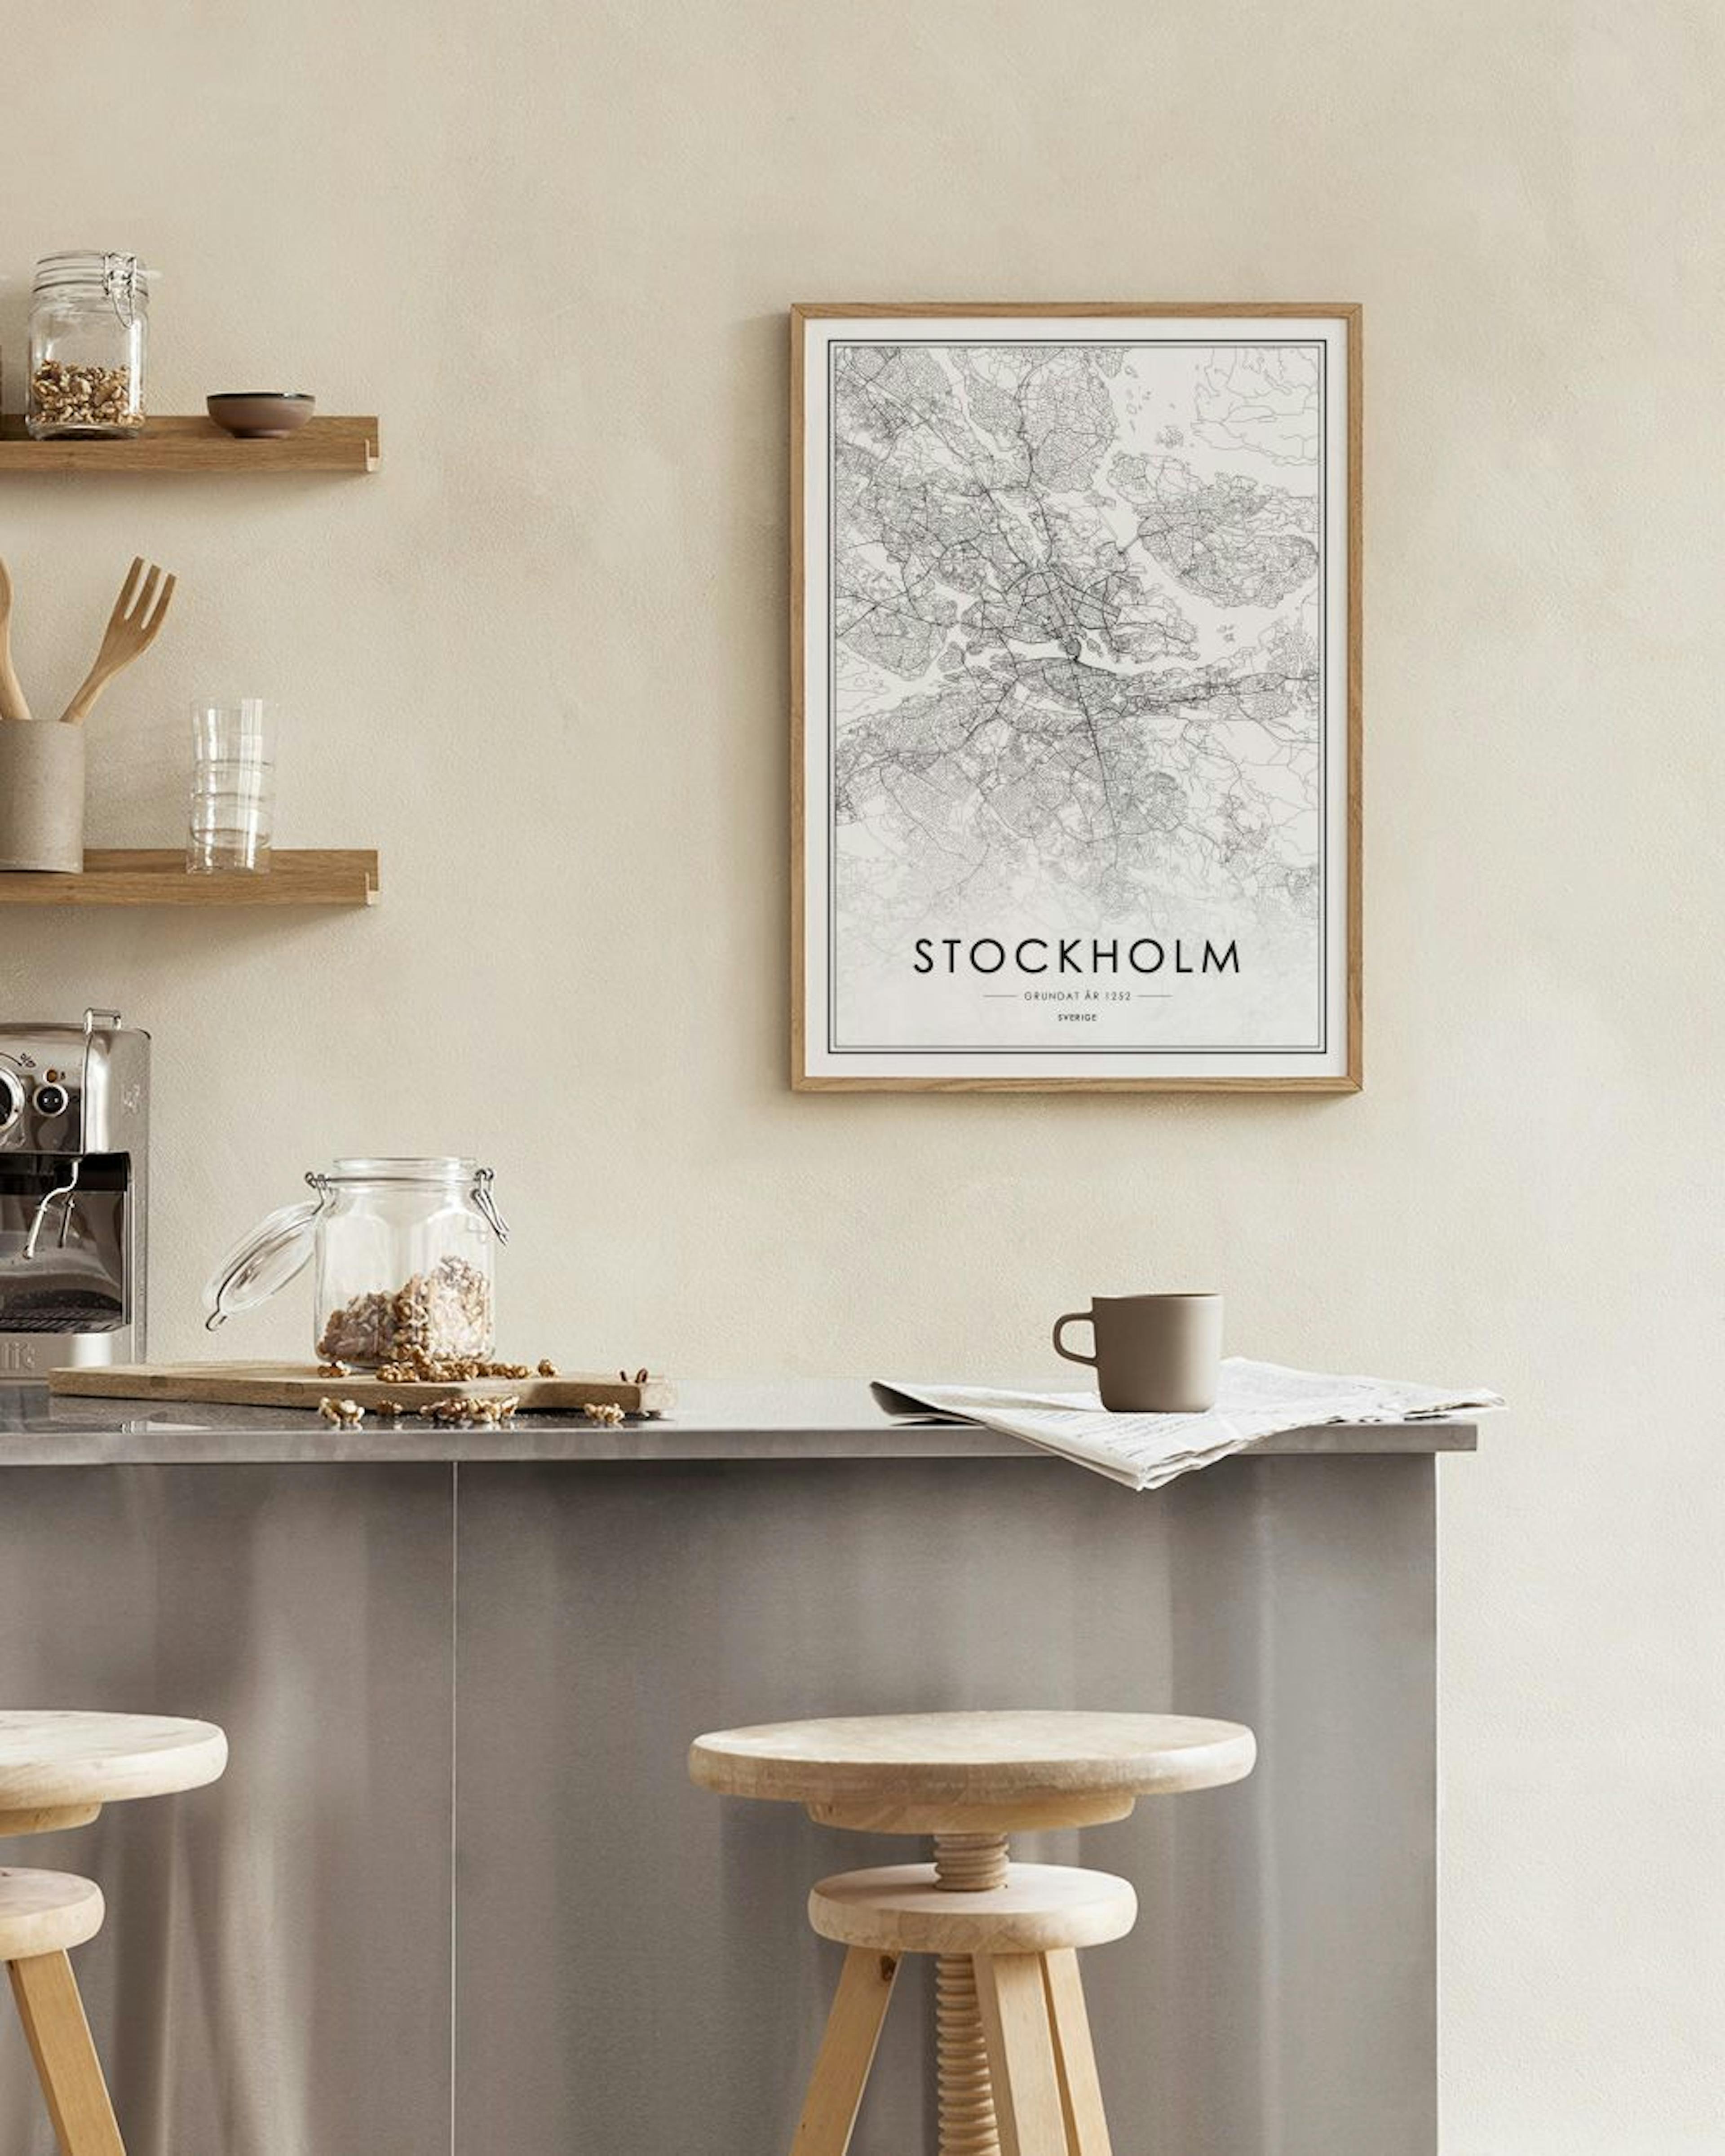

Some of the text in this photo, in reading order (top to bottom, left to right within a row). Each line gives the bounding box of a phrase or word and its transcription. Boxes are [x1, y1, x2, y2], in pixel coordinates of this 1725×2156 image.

[913, 938, 1239, 974] STOCKHOLM
[1024, 989, 1131, 1001] GRUNDAT ÅR 1252
[1057, 1013, 1097, 1022] SVERIGE
